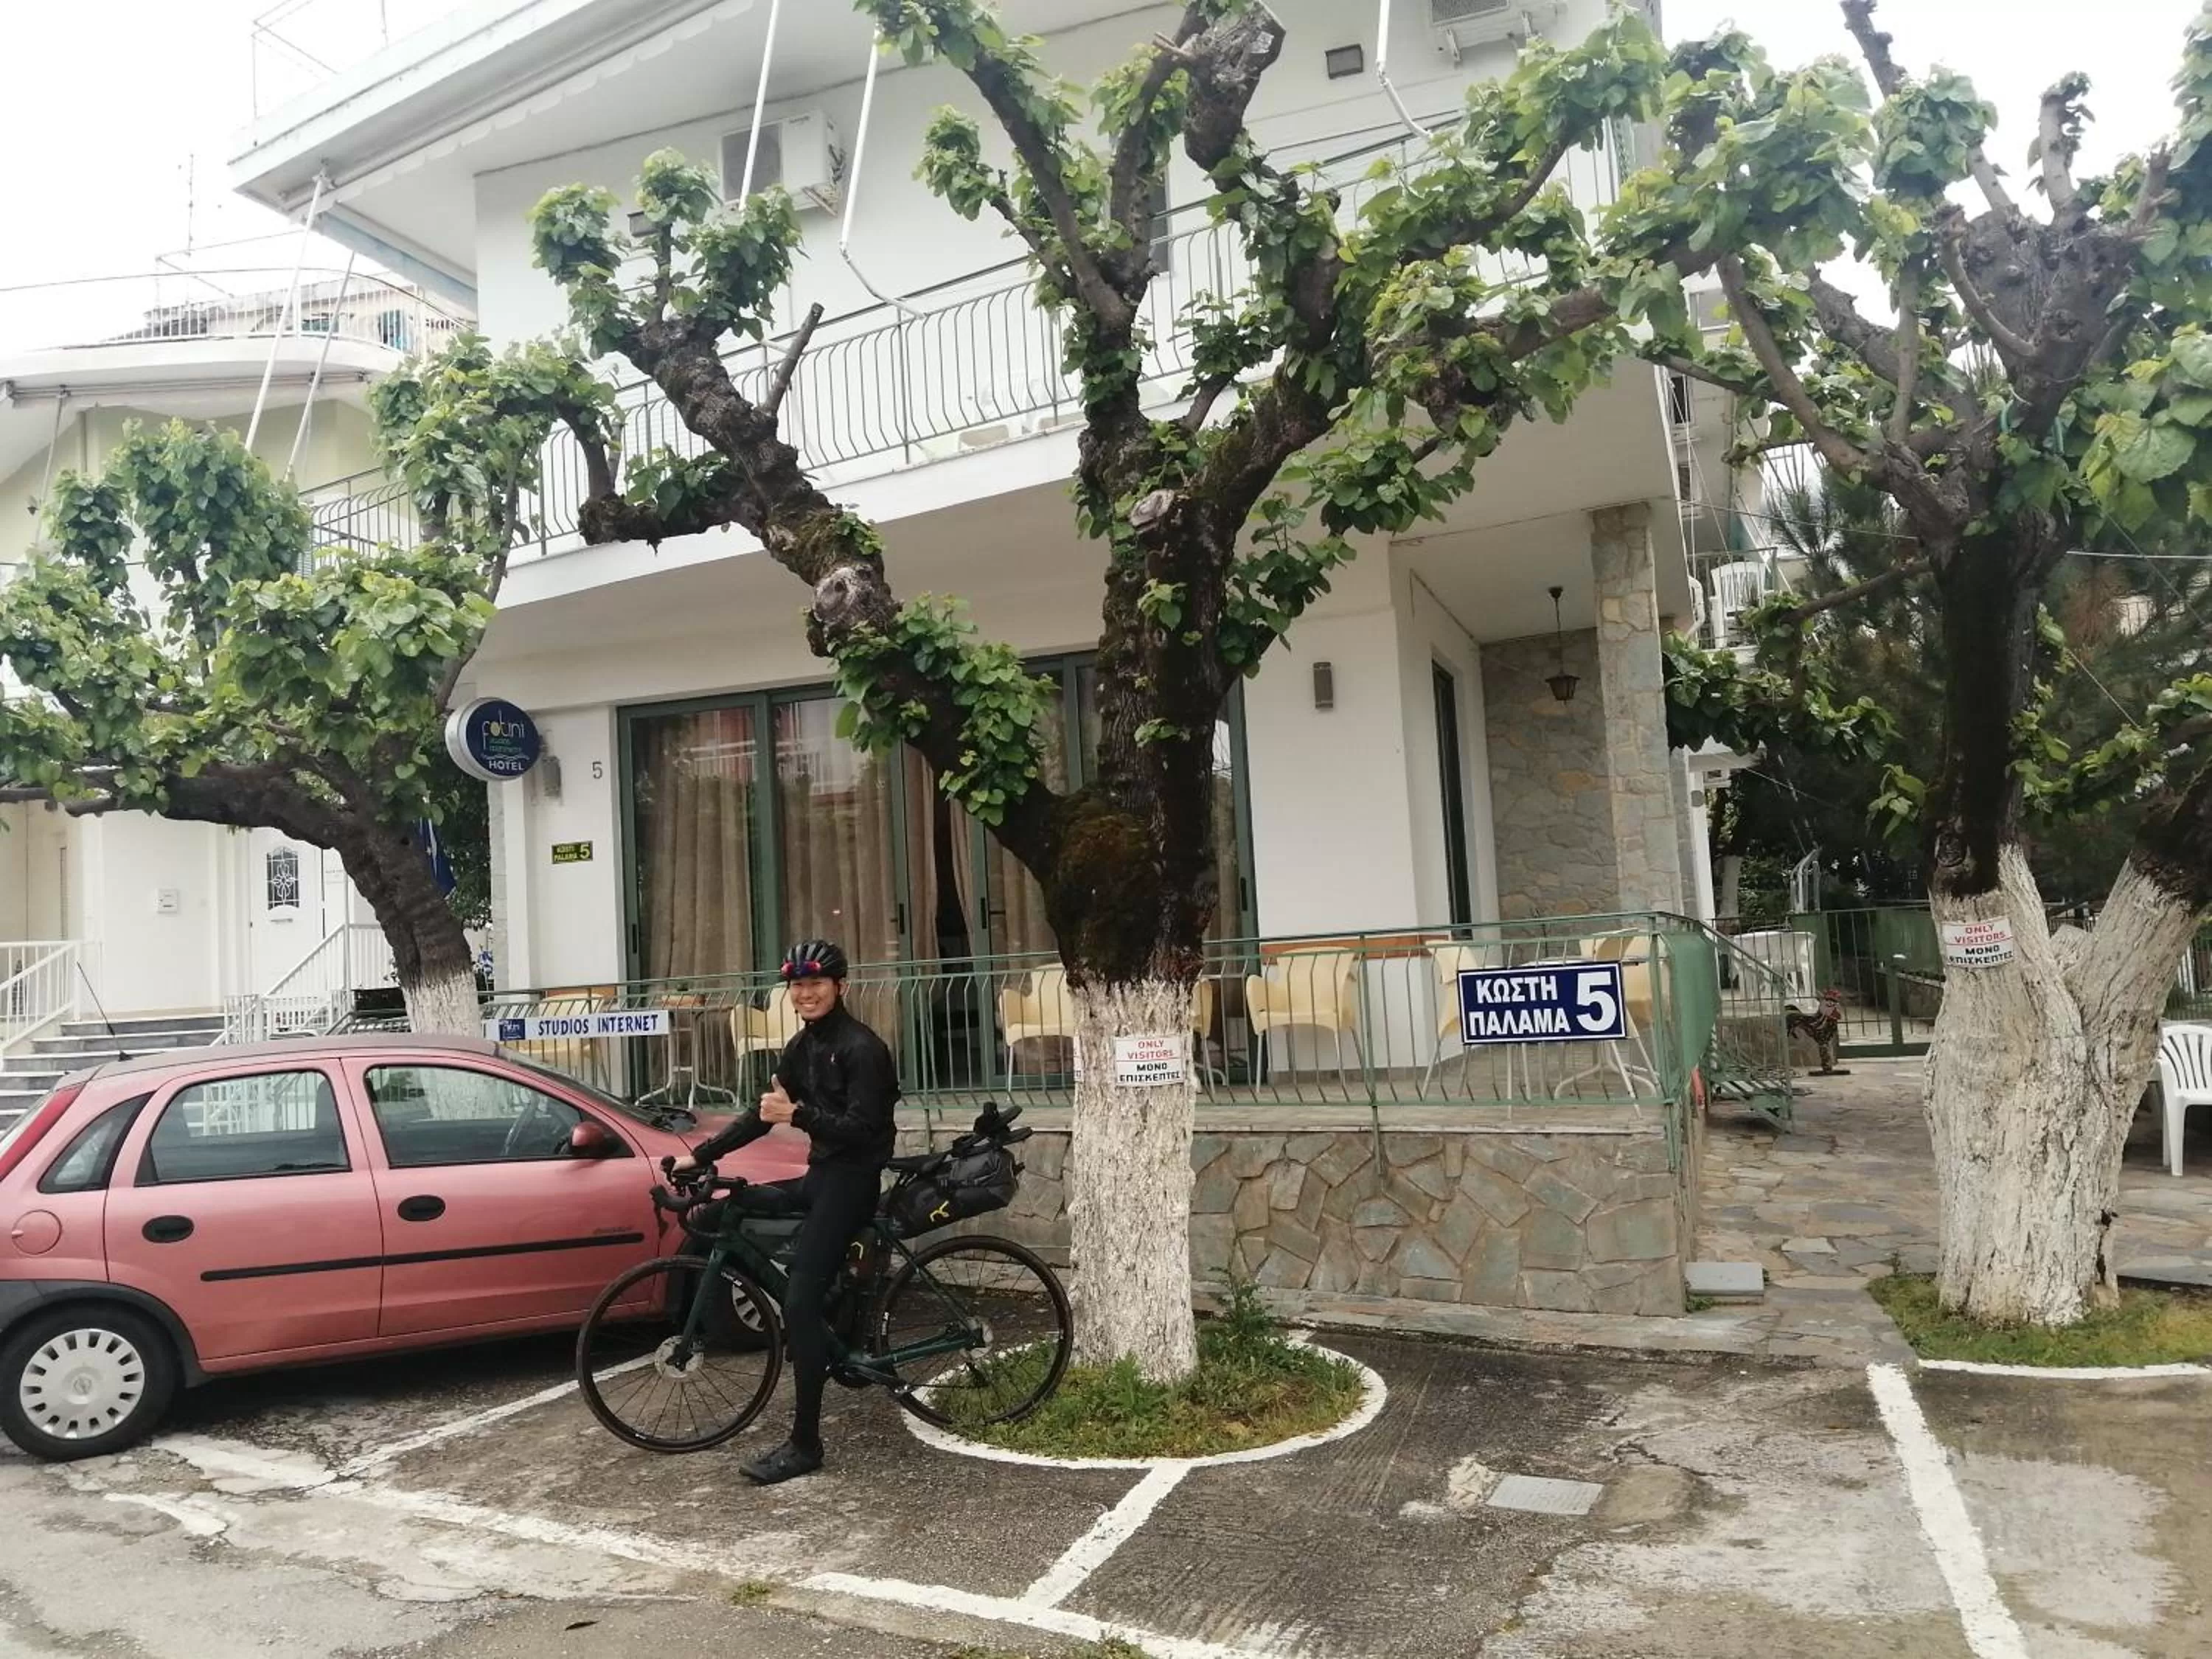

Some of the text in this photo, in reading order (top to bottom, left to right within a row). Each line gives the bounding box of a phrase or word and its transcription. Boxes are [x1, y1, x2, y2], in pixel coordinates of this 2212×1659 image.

[489, 760, 525, 771] HOTEL
[592, 761, 602, 779] 5
[580, 844, 590, 859] 5
[1965, 924, 1994, 934] ONLY
[1955, 931, 2006, 943] VISITORS
[1965, 945, 2000, 955] ΜΟΝΟ
[1475, 975, 1558, 1004] ΚΩΣΤΗ
[1576, 971, 1617, 1032] 5
[538, 1018, 589, 1036] STUDIOS
[598, 1015, 658, 1032] INTERNET
[1468, 1007, 1571, 1036] ΠΑΛΑΜΑ
[1138, 1040, 1164, 1048] ONLY
[1127, 1050, 1174, 1060] VISITORS
[1136, 1062, 1167, 1071] ΜΟΝΟ
